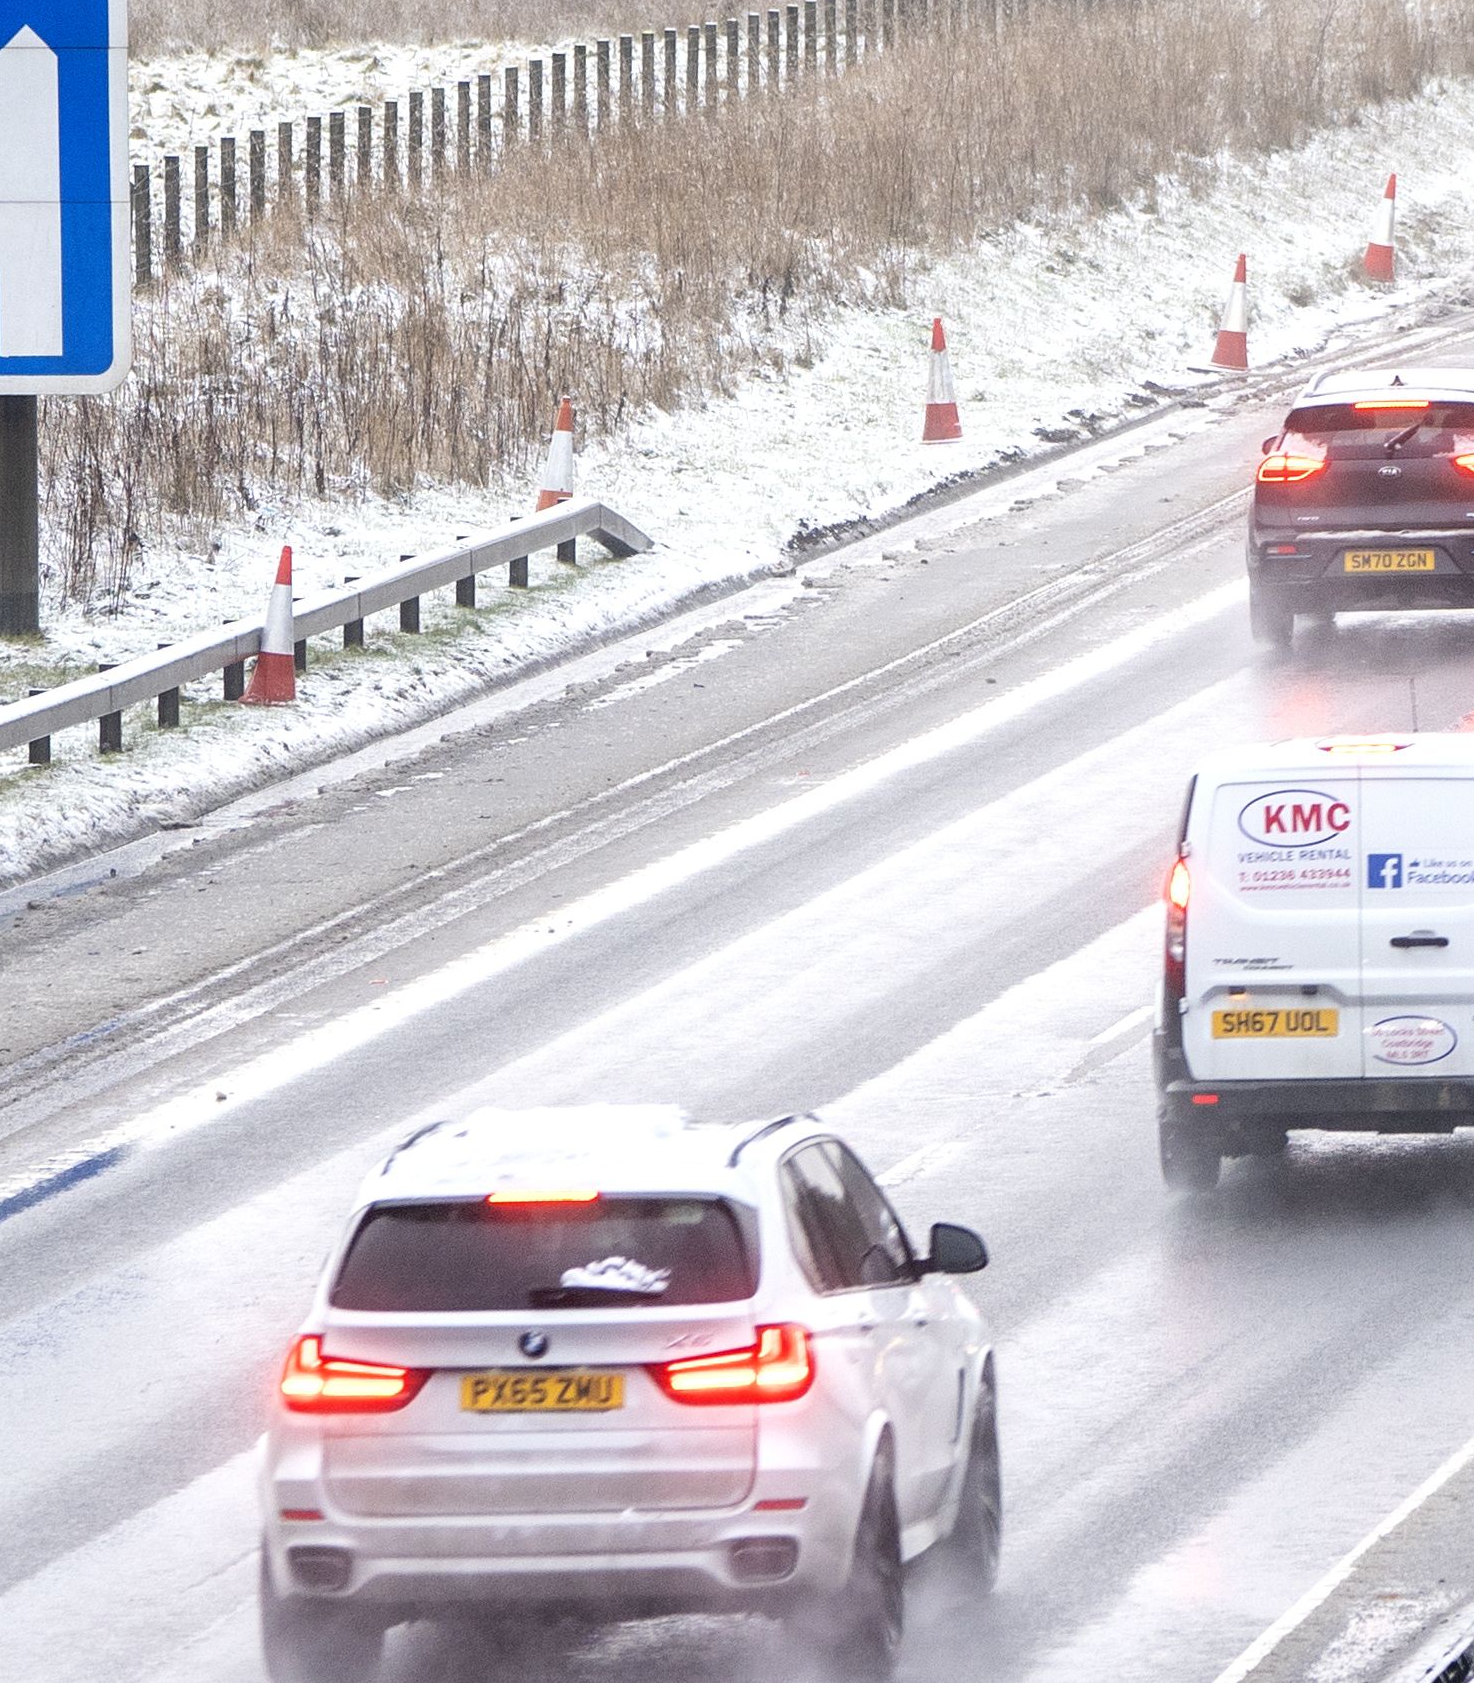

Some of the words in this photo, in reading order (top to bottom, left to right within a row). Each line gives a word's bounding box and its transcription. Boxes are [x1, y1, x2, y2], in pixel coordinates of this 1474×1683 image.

[1351, 553, 1392, 569] SM70
[1395, 552, 1427, 568] ZGN
[1262, 802, 1351, 834] KMC
[1237, 849, 1294, 864] VEHICLE
[1298, 847, 1352, 861] RENTAL
[1221, 1013, 1279, 1034] SH67
[1284, 1010, 1330, 1033] UOL
[472, 1378, 549, 1408] PX65
